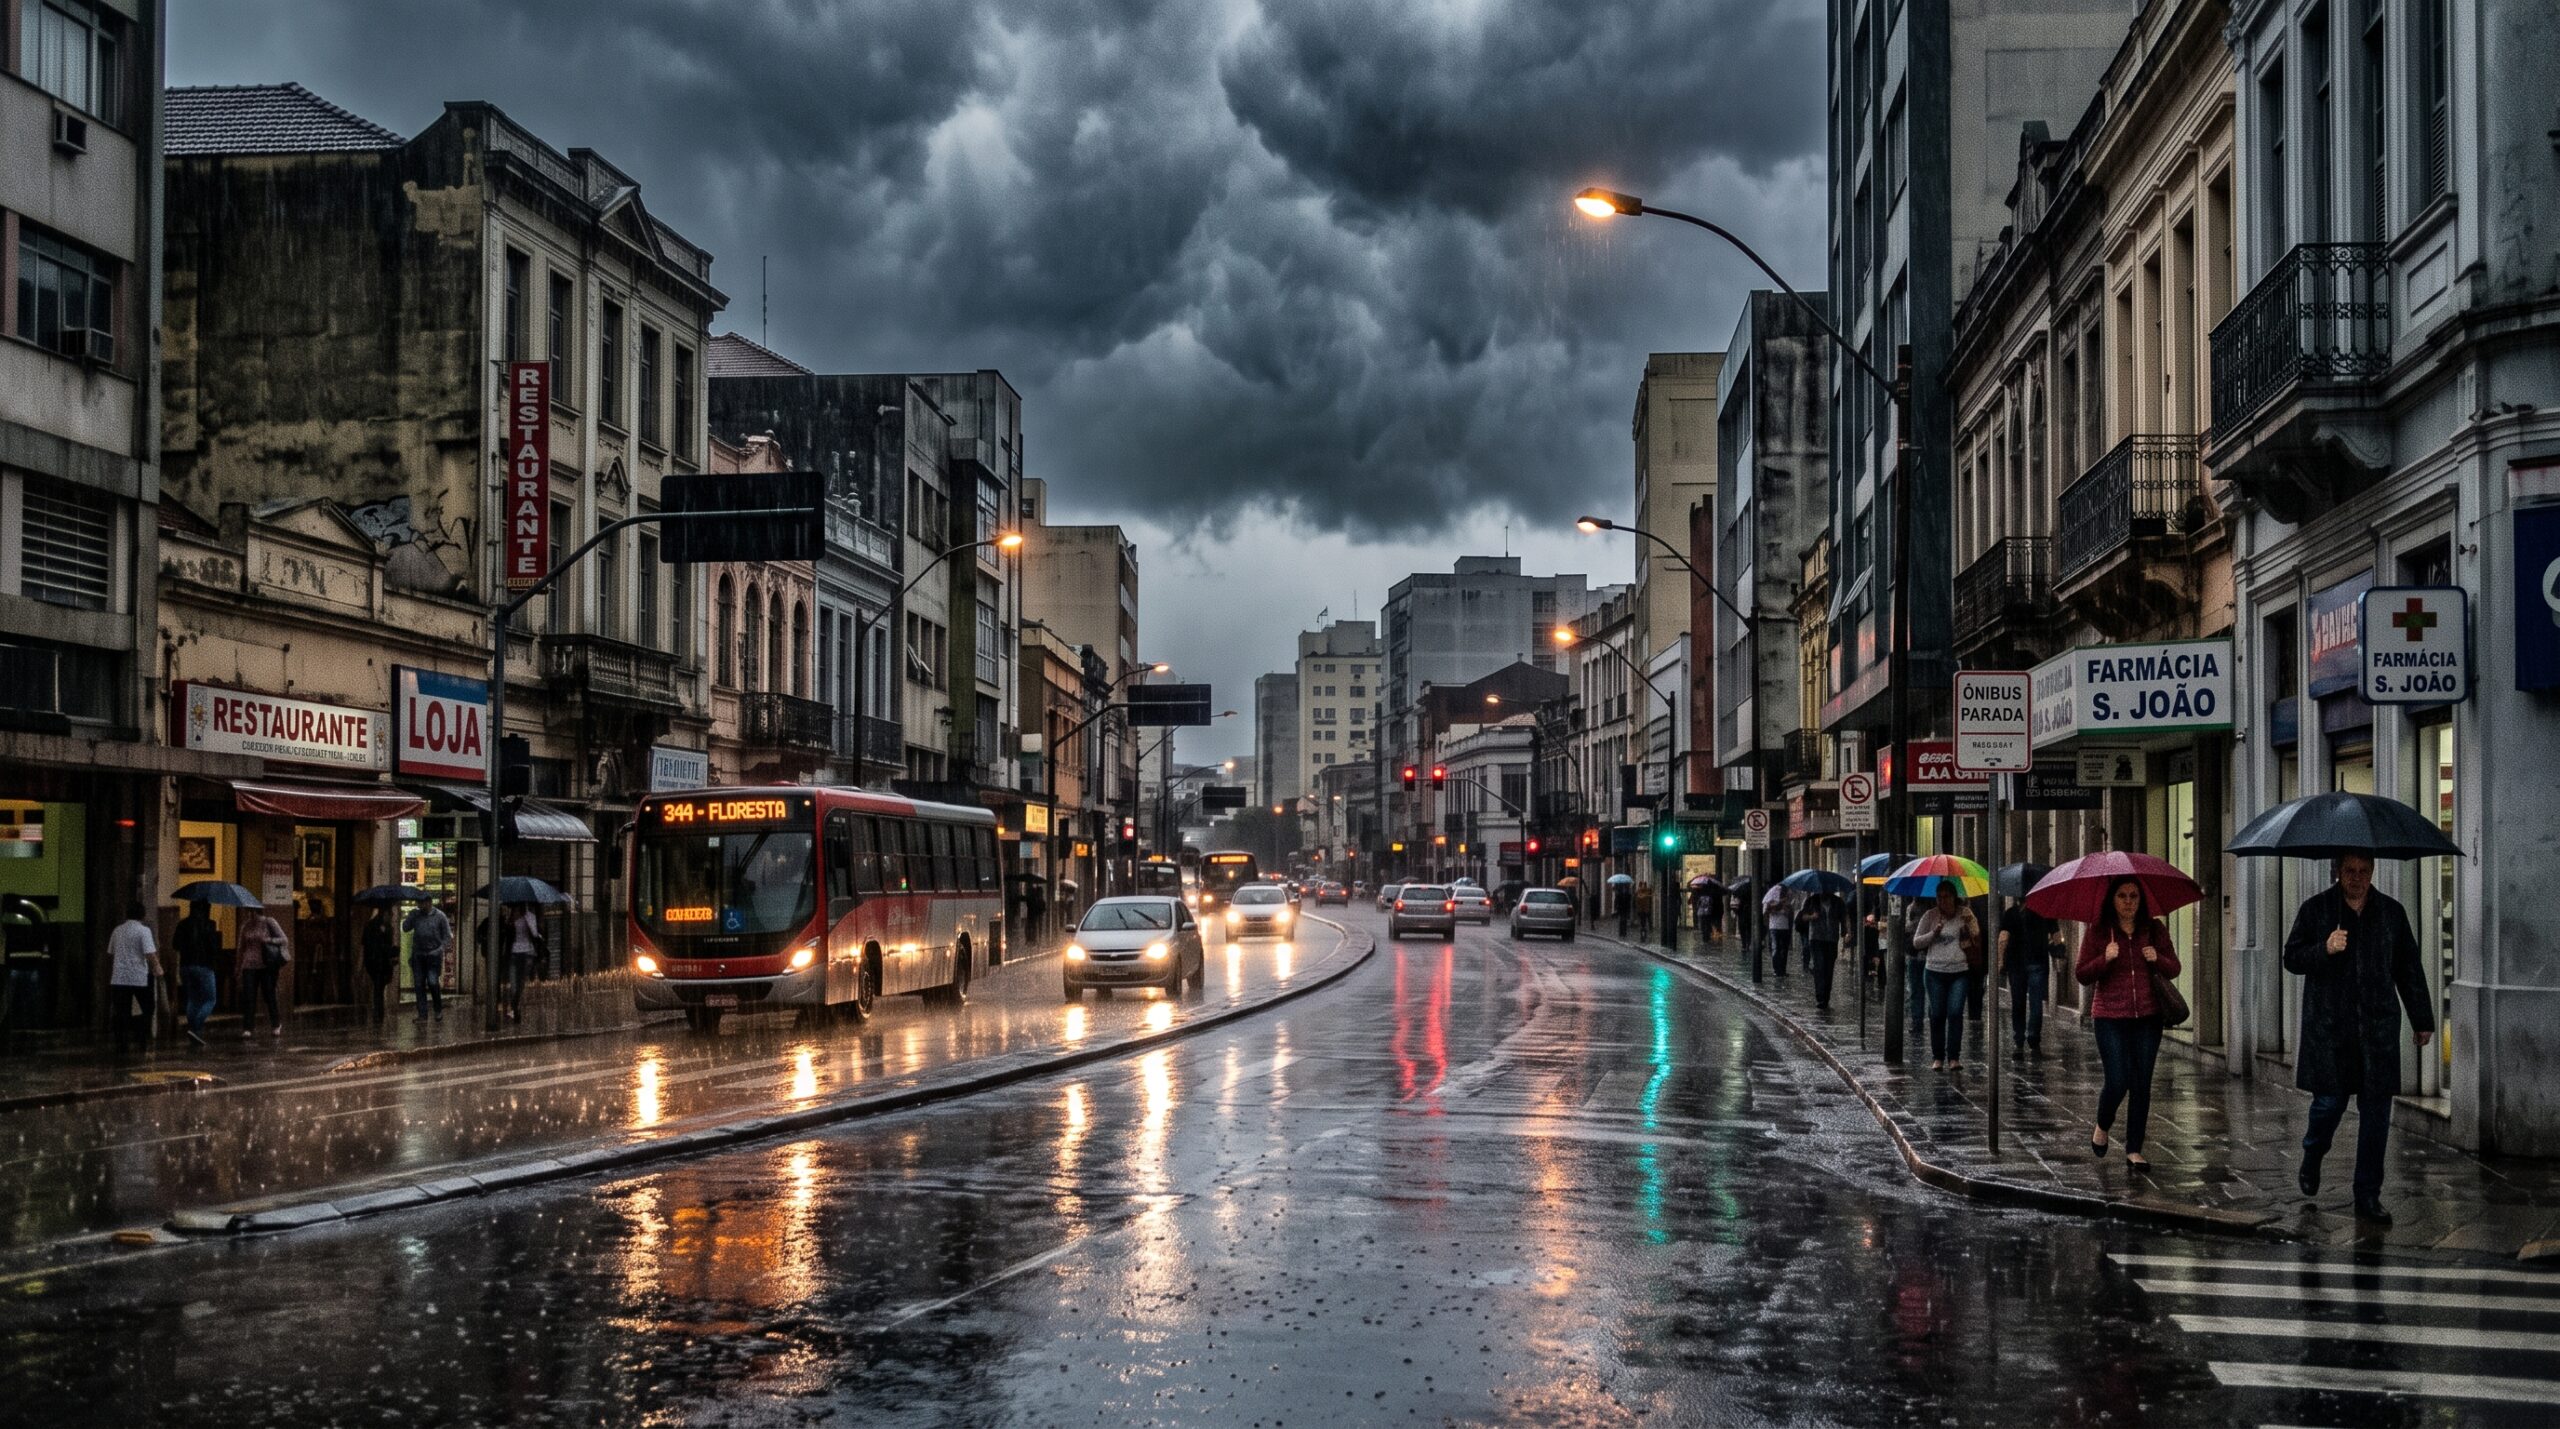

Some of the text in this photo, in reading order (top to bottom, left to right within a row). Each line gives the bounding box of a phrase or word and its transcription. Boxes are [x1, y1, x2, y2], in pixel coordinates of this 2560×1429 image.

[516, 368, 541, 574] RESTAURANTE
[2087, 650, 2220, 684] FARMÁCIA
[2373, 649, 2457, 668] FARMÁCIA
[1963, 683, 2022, 700] ÔNIBUS
[2375, 671, 2456, 693] S. JOÃO
[1961, 707, 2024, 721] PARADA
[2092, 682, 2216, 721] S. JOÃO
[213, 696, 367, 748] RESTAURANTE
[408, 697, 482, 757] LOJA
[664, 803, 693, 821] 344
[709, 801, 786, 820] FLORESTA
